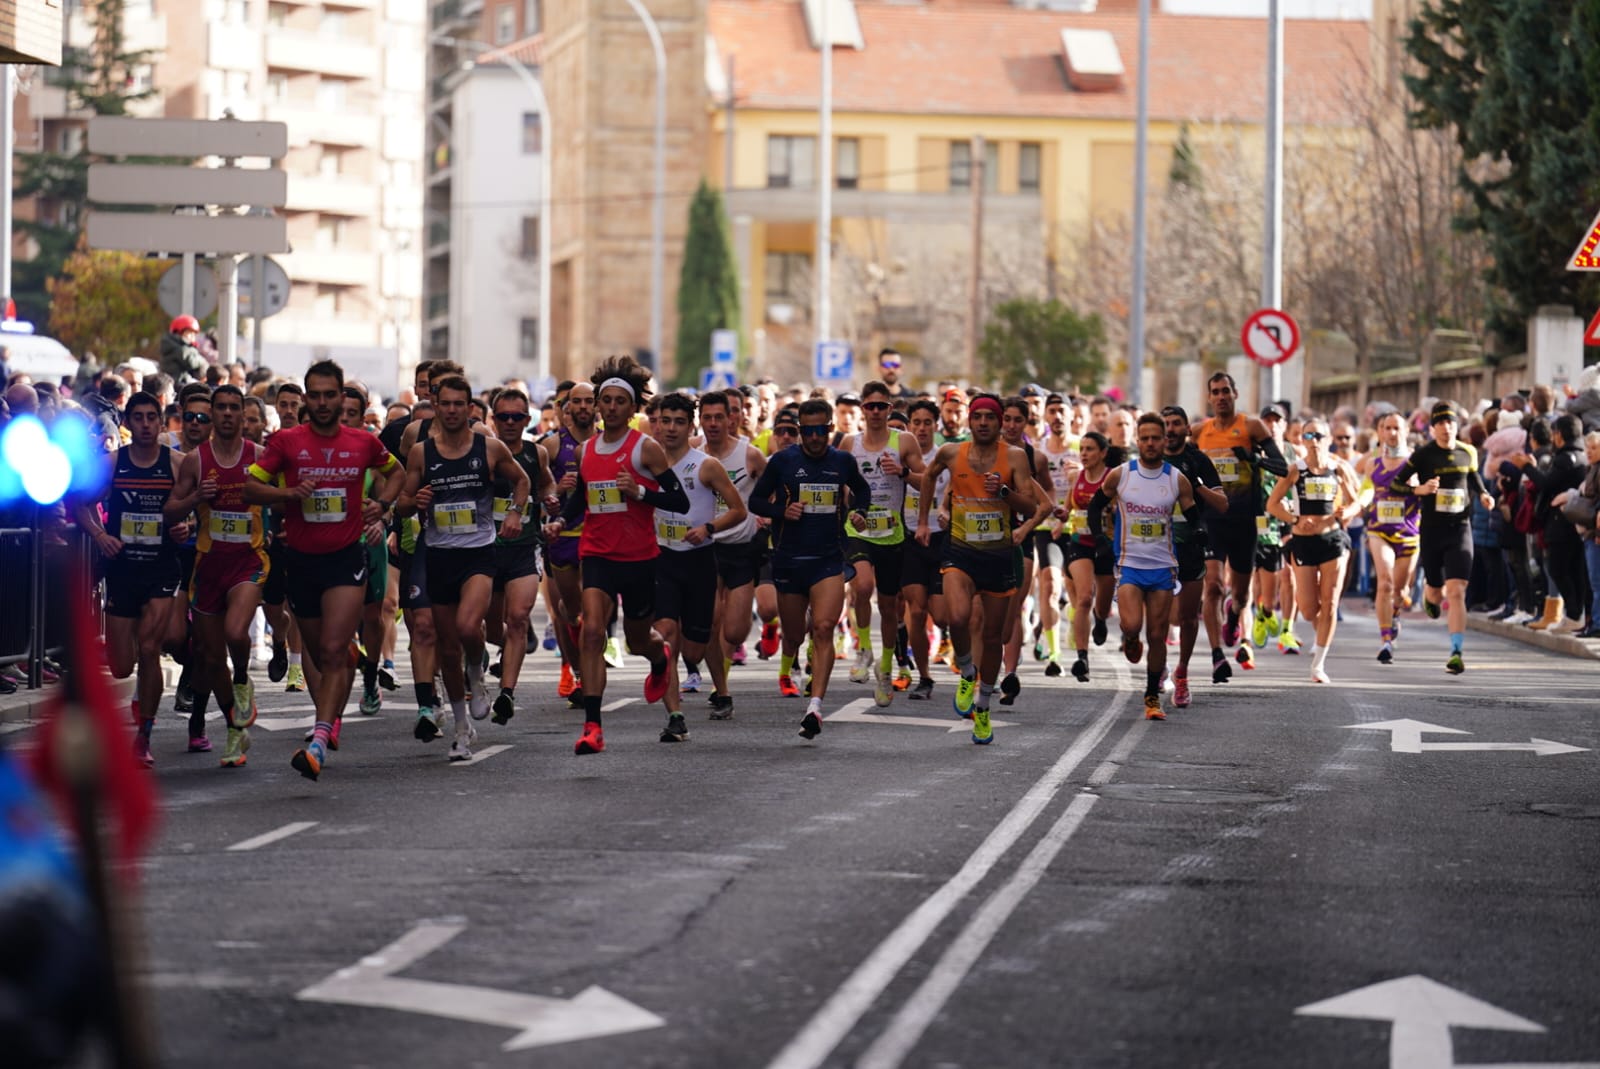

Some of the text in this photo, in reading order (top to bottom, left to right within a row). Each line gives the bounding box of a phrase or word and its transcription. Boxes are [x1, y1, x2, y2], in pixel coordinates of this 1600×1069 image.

[821, 345, 848, 373] P
[599, 490, 606, 503] 3
[812, 492, 822, 503] 14
[314, 498, 329, 512] 83
[448, 512, 457, 523] 11
[866, 518, 878, 529] 69
[133, 521, 144, 535] 12
[222, 520, 235, 532] 25
[977, 520, 990, 532] 23
[1140, 524, 1153, 535] 98
[666, 526, 676, 539] 81
